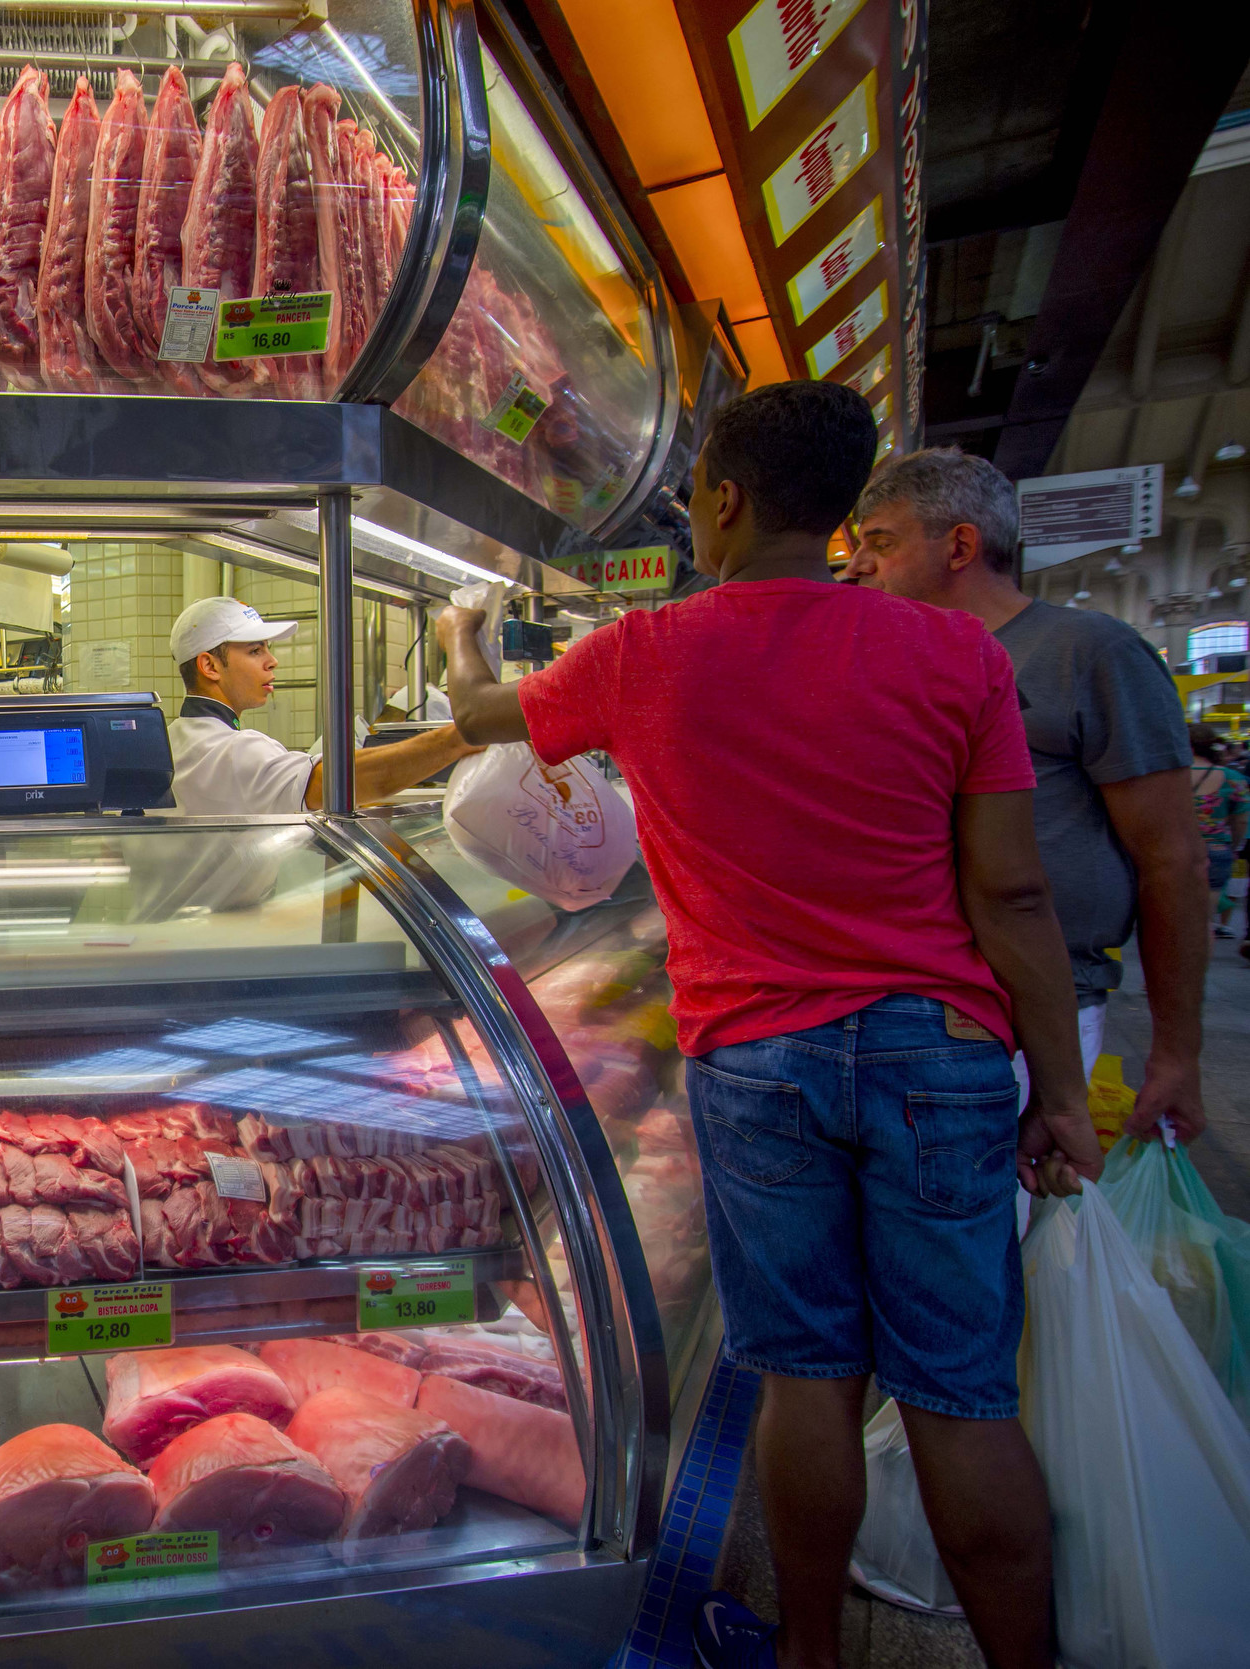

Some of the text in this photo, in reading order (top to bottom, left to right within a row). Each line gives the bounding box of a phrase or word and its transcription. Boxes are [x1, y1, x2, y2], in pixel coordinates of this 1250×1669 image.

[793, 121, 844, 206] Capivara
[819, 237, 854, 290] Cateto
[276, 311, 311, 324] PANCETA
[252, 332, 291, 349] 16,80
[605, 556, 666, 582] CAIXA
[25, 790, 45, 801] prix
[93, 1288, 129, 1296] Porco
[416, 1281, 451, 1293] TORRESMO
[98, 1303, 159, 1316] BISTECA DA COPA
[395, 1300, 436, 1319] 13,80
[86, 1322, 130, 1341] 12,80
[136, 1538, 172, 1546] Pco
[135, 1552, 208, 1567] PERNIL COM OSSO
